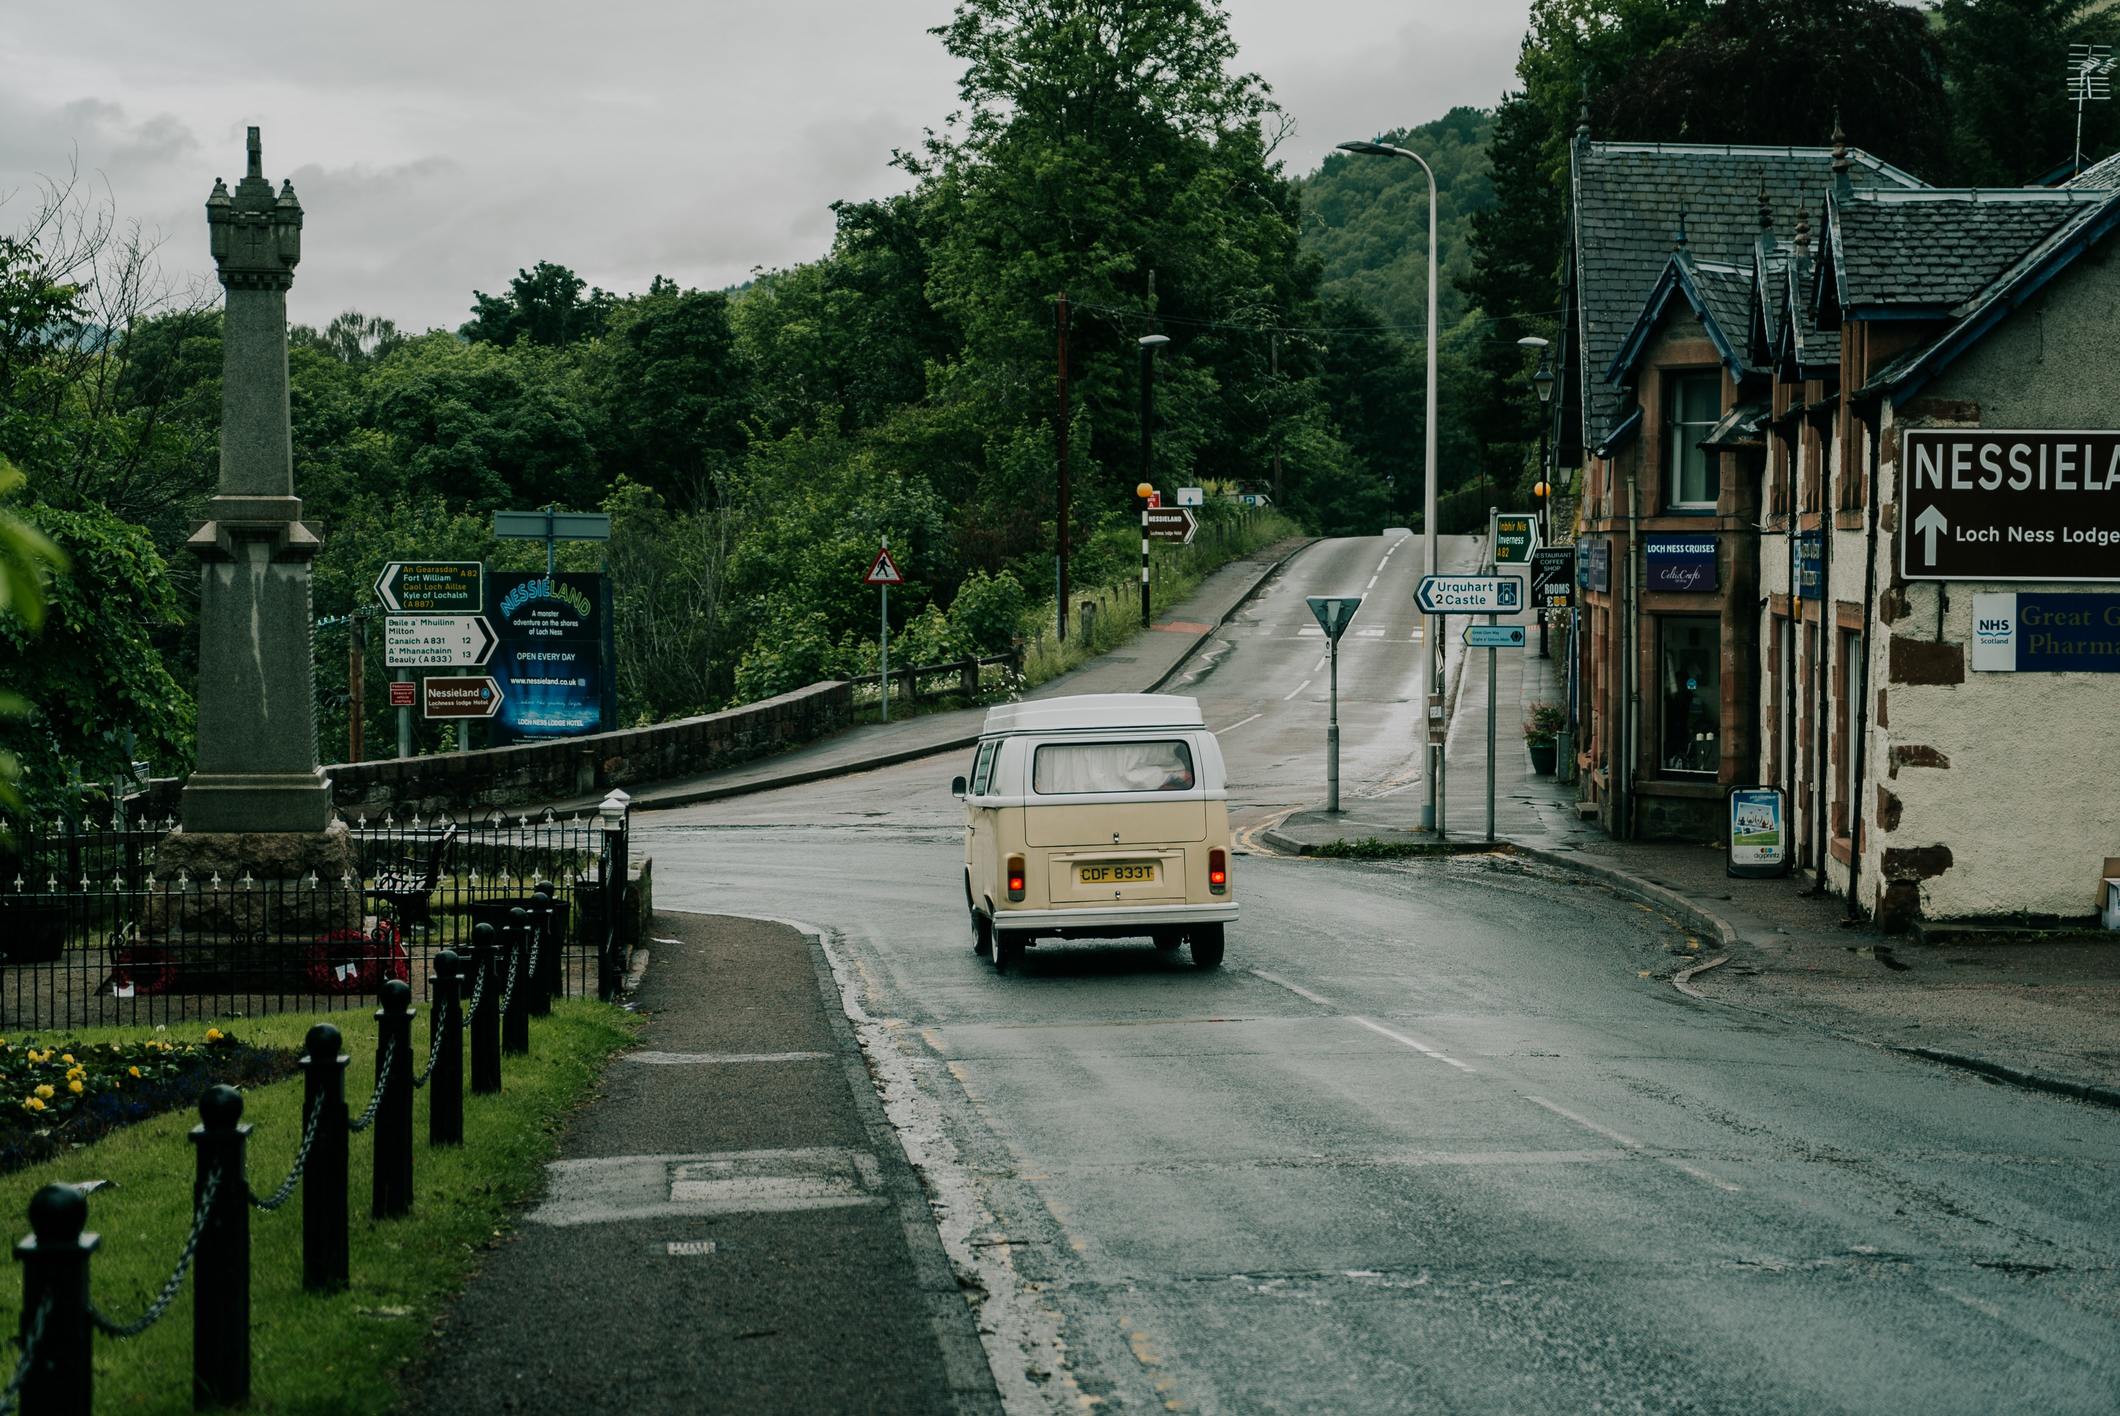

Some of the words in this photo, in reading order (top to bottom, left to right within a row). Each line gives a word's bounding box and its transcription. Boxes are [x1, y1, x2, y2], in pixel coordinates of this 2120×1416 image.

[1914, 443, 2120, 491] NESSIELA
[1497, 534, 1524, 545] Inverness
[1956, 526, 2000, 542] Loch
[2008, 526, 2055, 543] Ness
[2063, 526, 2120, 546] Lodge
[1497, 547, 1510, 558] A82
[1647, 544, 1666, 554] LOCH
[1666, 544, 1685, 553] NESS
[1685, 544, 1715, 554] CRUISES
[403, 574, 420, 582] Fort
[422, 574, 452, 582] William
[1437, 582, 1494, 593] Urquhart
[1544, 584, 1570, 594] ROOMS
[403, 592, 421, 600] Kyle
[500, 579, 591, 617] NESSIELAND
[1436, 594, 1443, 604] 2
[1445, 595, 1486, 605] Castle
[2020, 605, 2092, 626] Great
[549, 619, 559, 627] the
[560, 619, 579, 627] shores
[1979, 620, 2009, 630] NHS
[389, 627, 414, 635] Milton
[528, 627, 535, 635] of
[536, 628, 548, 636] Loch
[549, 628, 563, 636] Ness
[2027, 633, 2120, 655] Pharma
[399, 647, 452, 655] Mhanachainn
[389, 656, 416, 664] Beauly
[516, 652, 536, 661] OPEN
[537, 652, 560, 661] EVERY
[561, 653, 576, 661] DAY
[510, 677, 577, 686] www.nessieland.co.uk
[428, 688, 480, 698] Nessieland
[548, 719, 566, 727] LODGE
[1081, 868, 1110, 881] CDF
[1114, 866, 1153, 880] 833T
